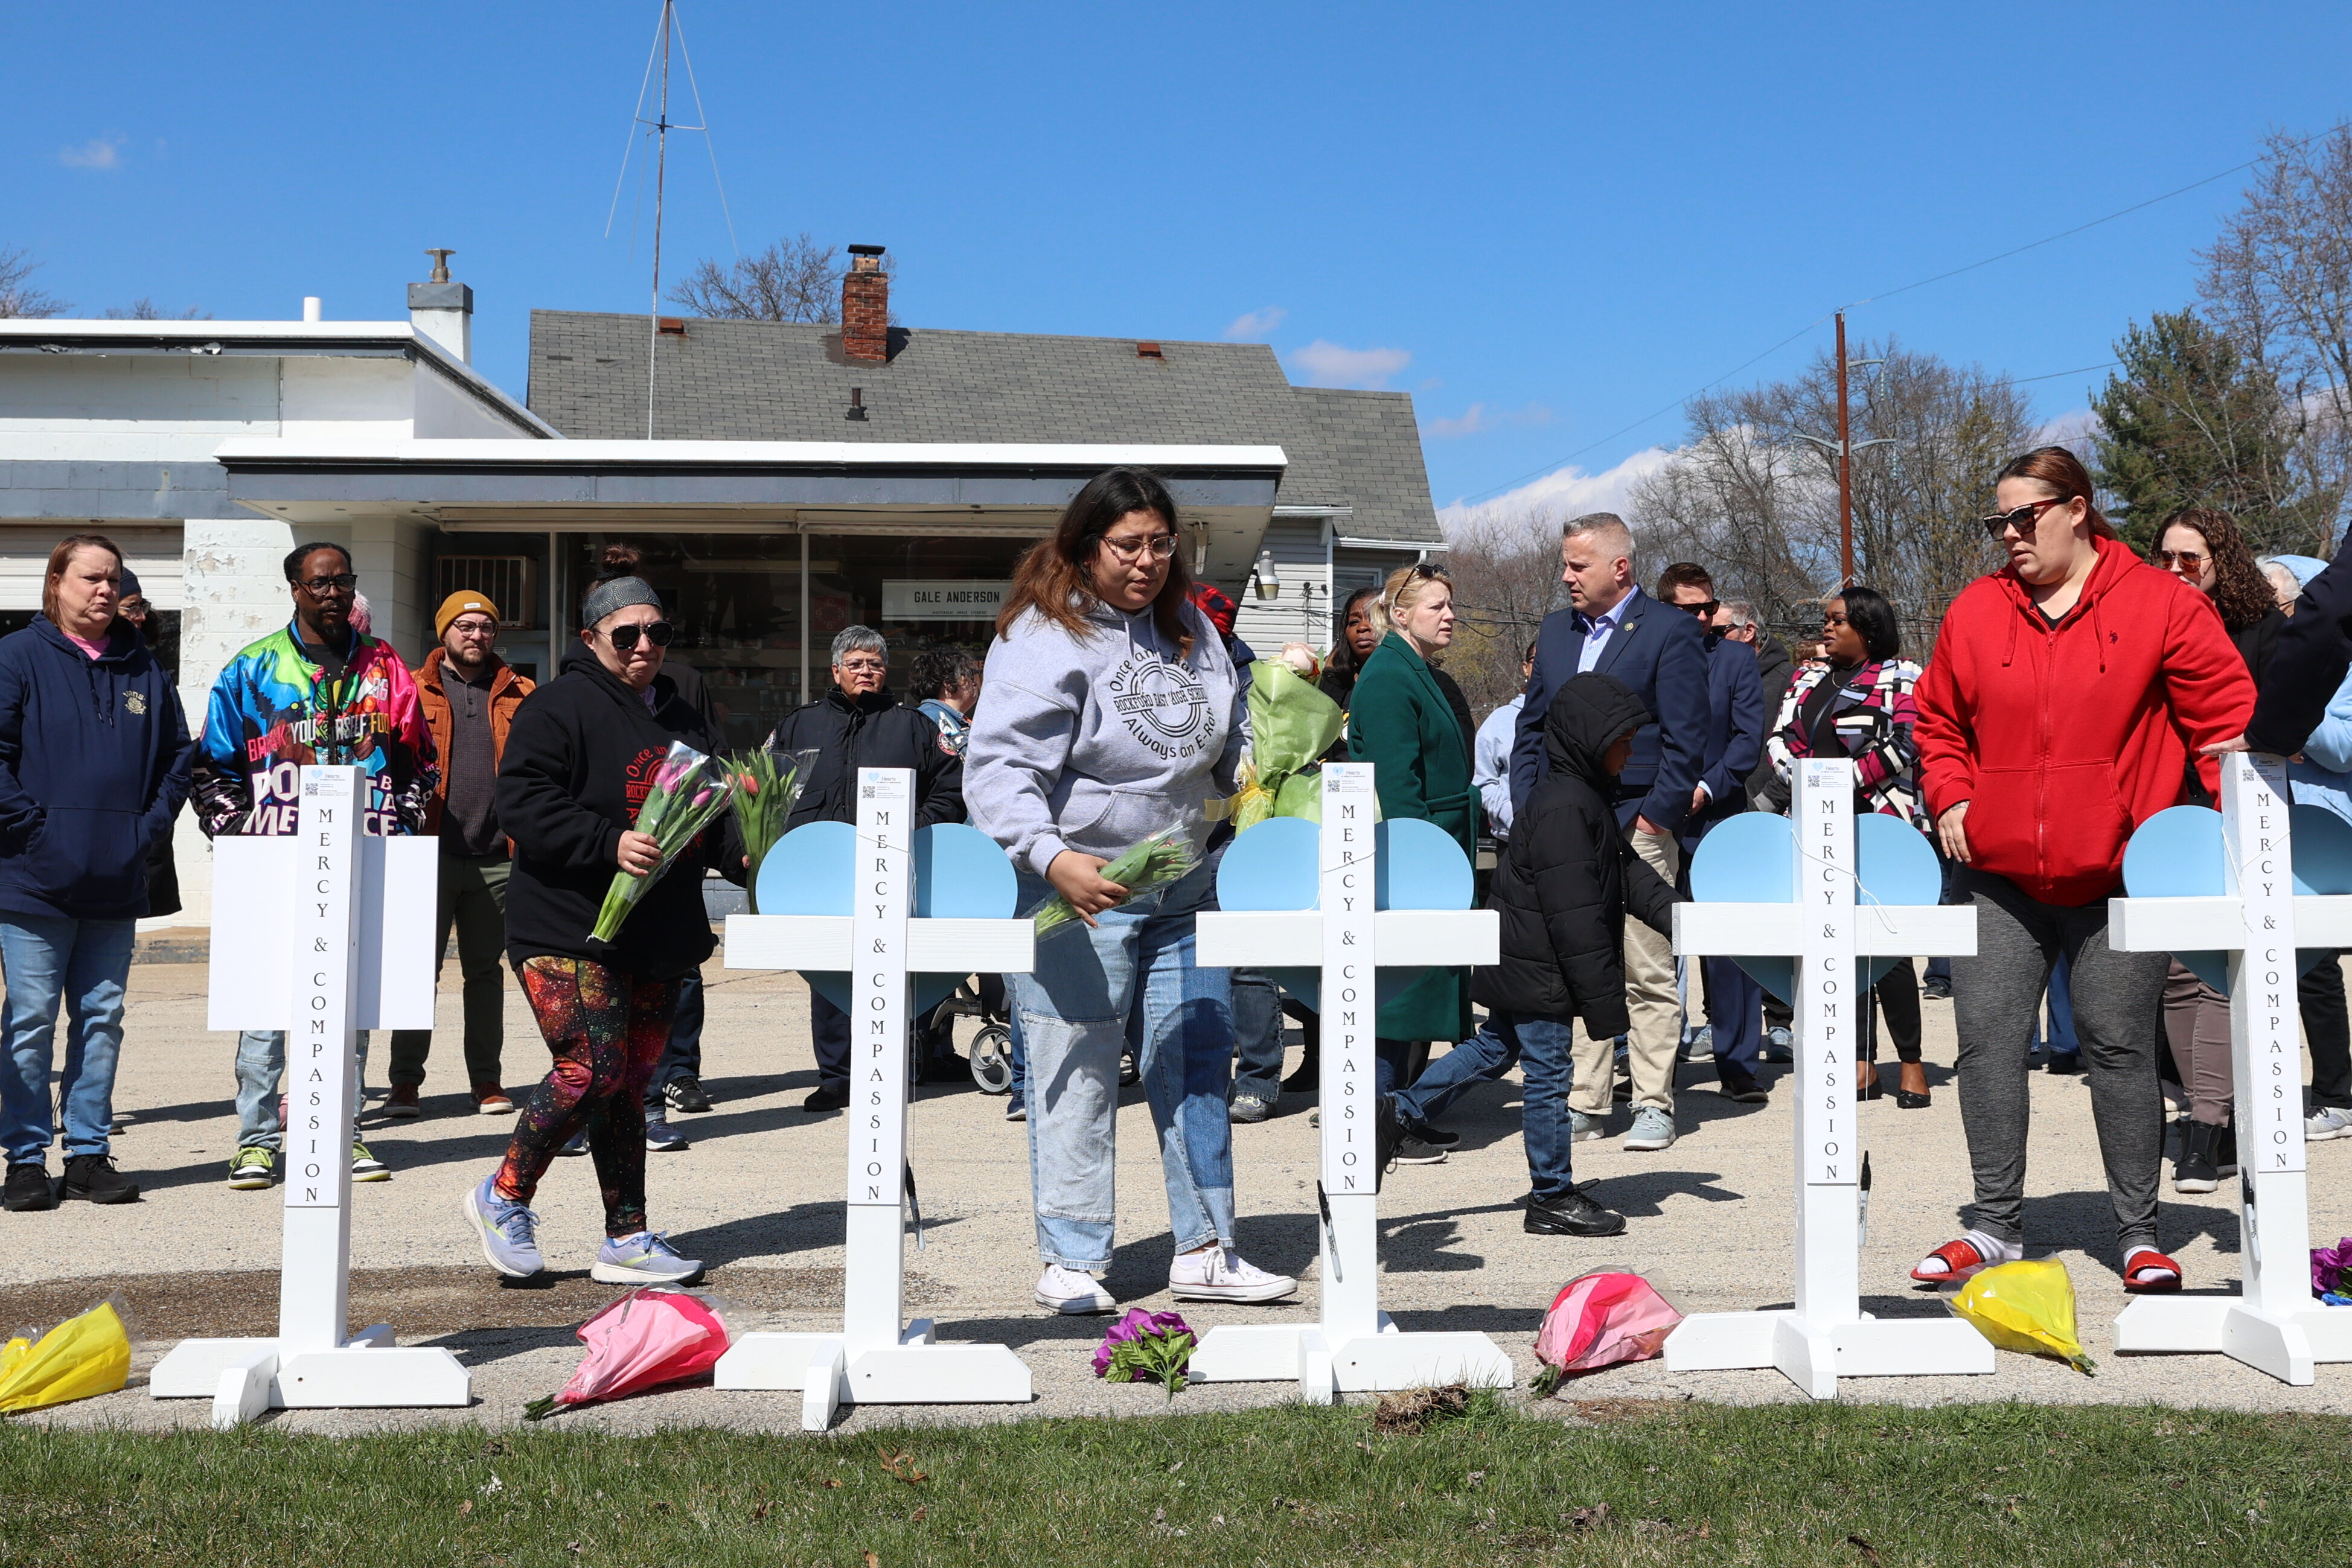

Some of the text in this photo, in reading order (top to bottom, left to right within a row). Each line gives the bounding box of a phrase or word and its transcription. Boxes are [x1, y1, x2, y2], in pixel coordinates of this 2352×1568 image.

[915, 591, 1000, 603] GALE ANDERSON
[1110, 647, 1197, 692] Once an -Rab
[1113, 693, 1154, 712] ROCKFORD
[1153, 693, 1169, 707] EAST
[1168, 690, 1189, 706] HIGH
[626, 748, 653, 777] Once
[1122, 707, 1215, 760] Always an E-Rab
[2258, 794, 2272, 896] MERCY
[2263, 917, 2274, 929] &
[305, 809, 331, 1201] MERCY & COMPASSION
[868, 811, 889, 1199] MERCY & COMPASSION
[1342, 805, 1356, 1189] MERCY & COMPASSION
[1823, 800, 1838, 1179] MERCY & COMPASSION
[2266, 949, 2286, 1167] COMPASSION
